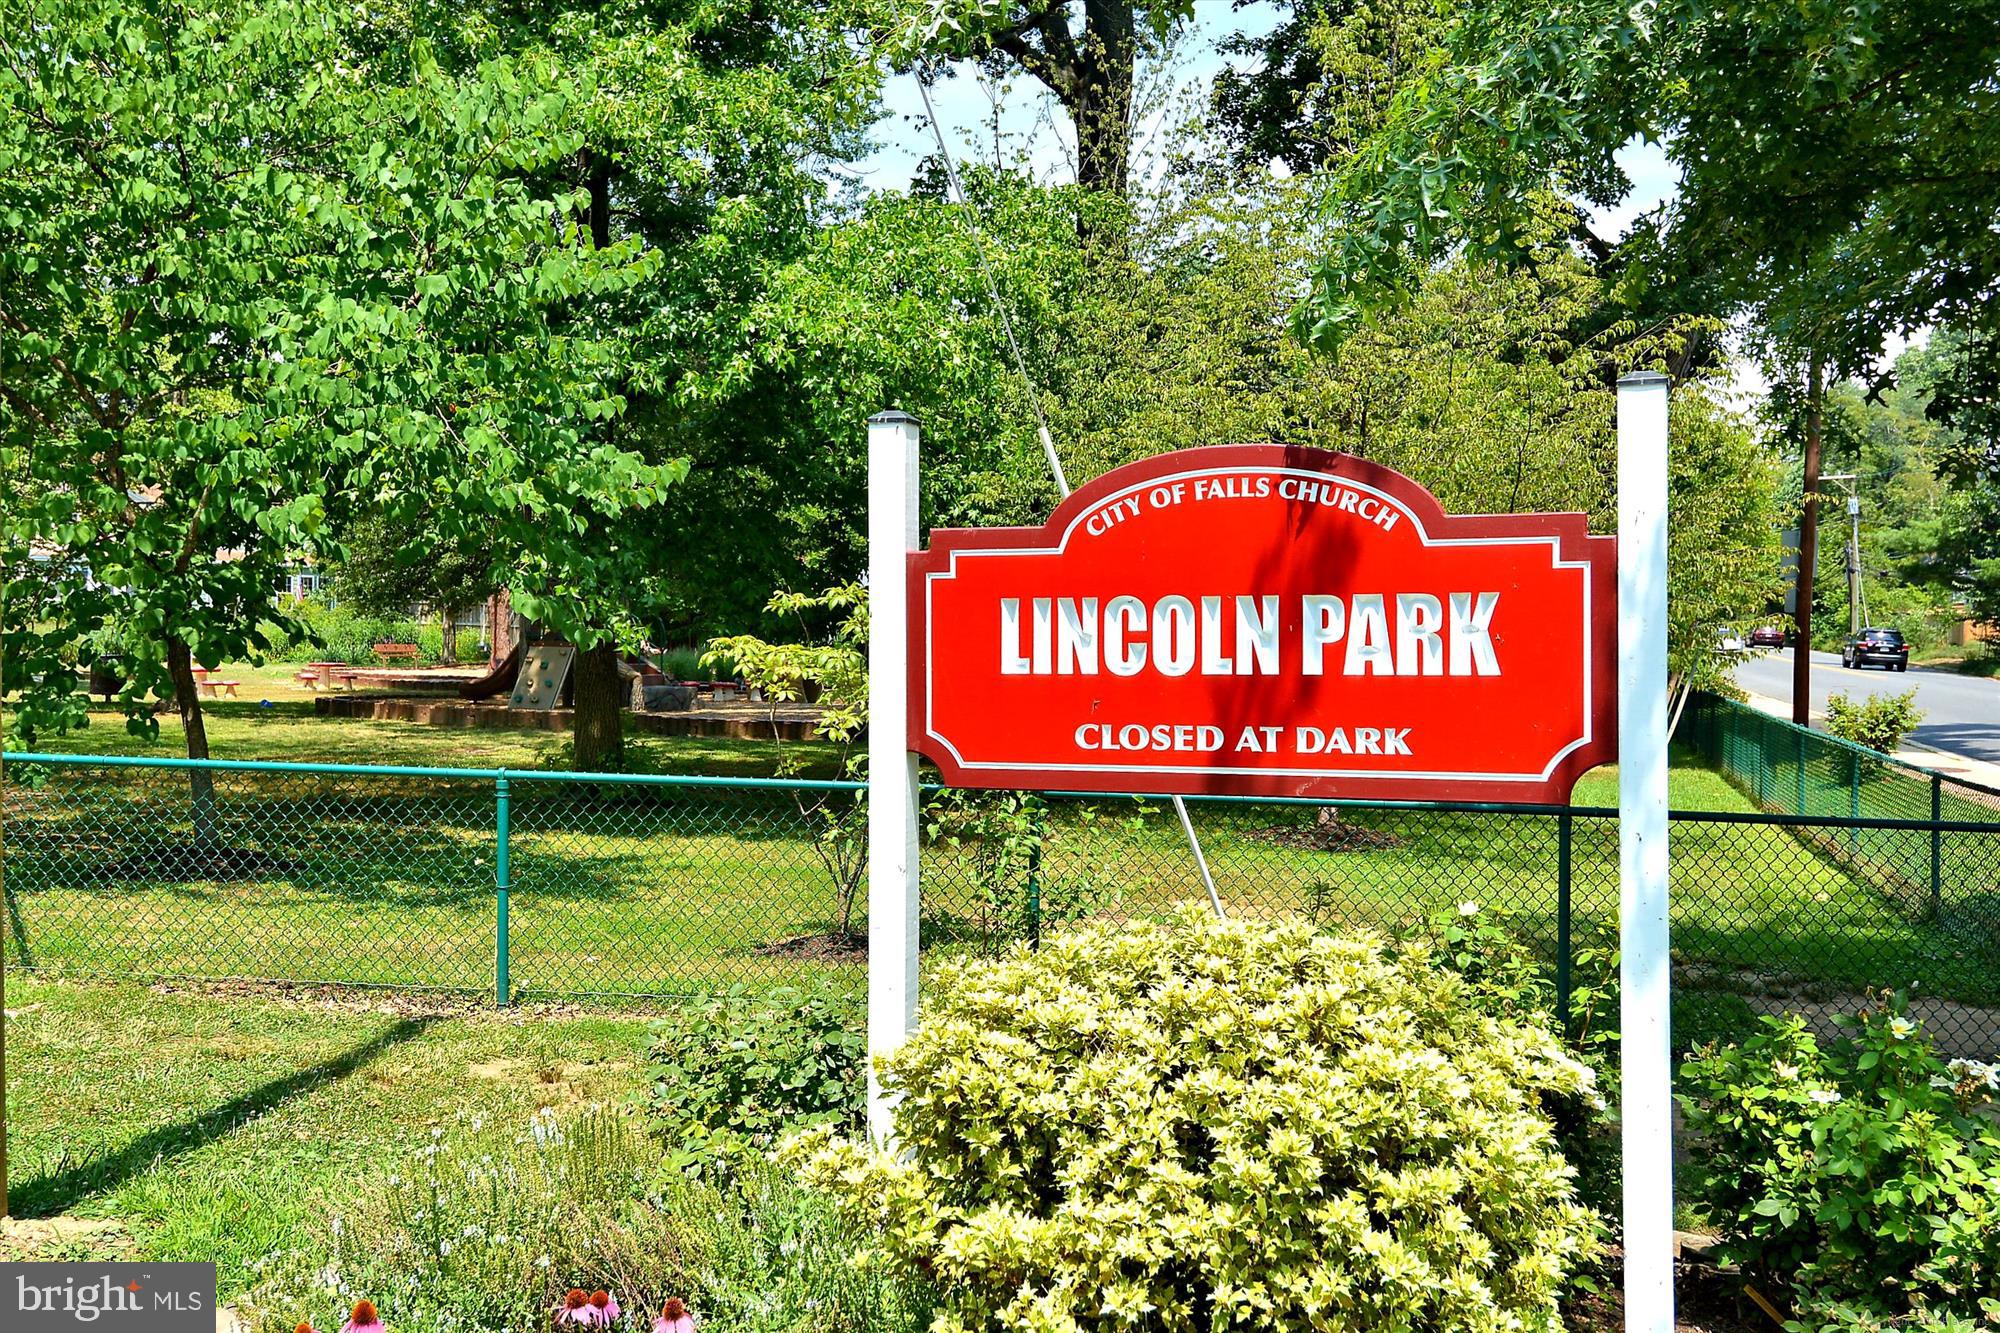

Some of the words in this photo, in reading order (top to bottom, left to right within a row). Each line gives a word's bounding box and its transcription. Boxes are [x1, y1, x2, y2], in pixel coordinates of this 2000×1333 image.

[1087, 493, 1141, 537] CITY
[1149, 482, 1186, 509] OF
[1194, 476, 1271, 501] FALLS
[1278, 478, 1401, 532] CHURCH
[1000, 594, 1280, 677] LINCOLN
[1302, 592, 1502, 677] PARK
[1075, 723, 1225, 752] CLOSED
[1234, 725, 1284, 753] AT
[1296, 726, 1413, 756] DARK
